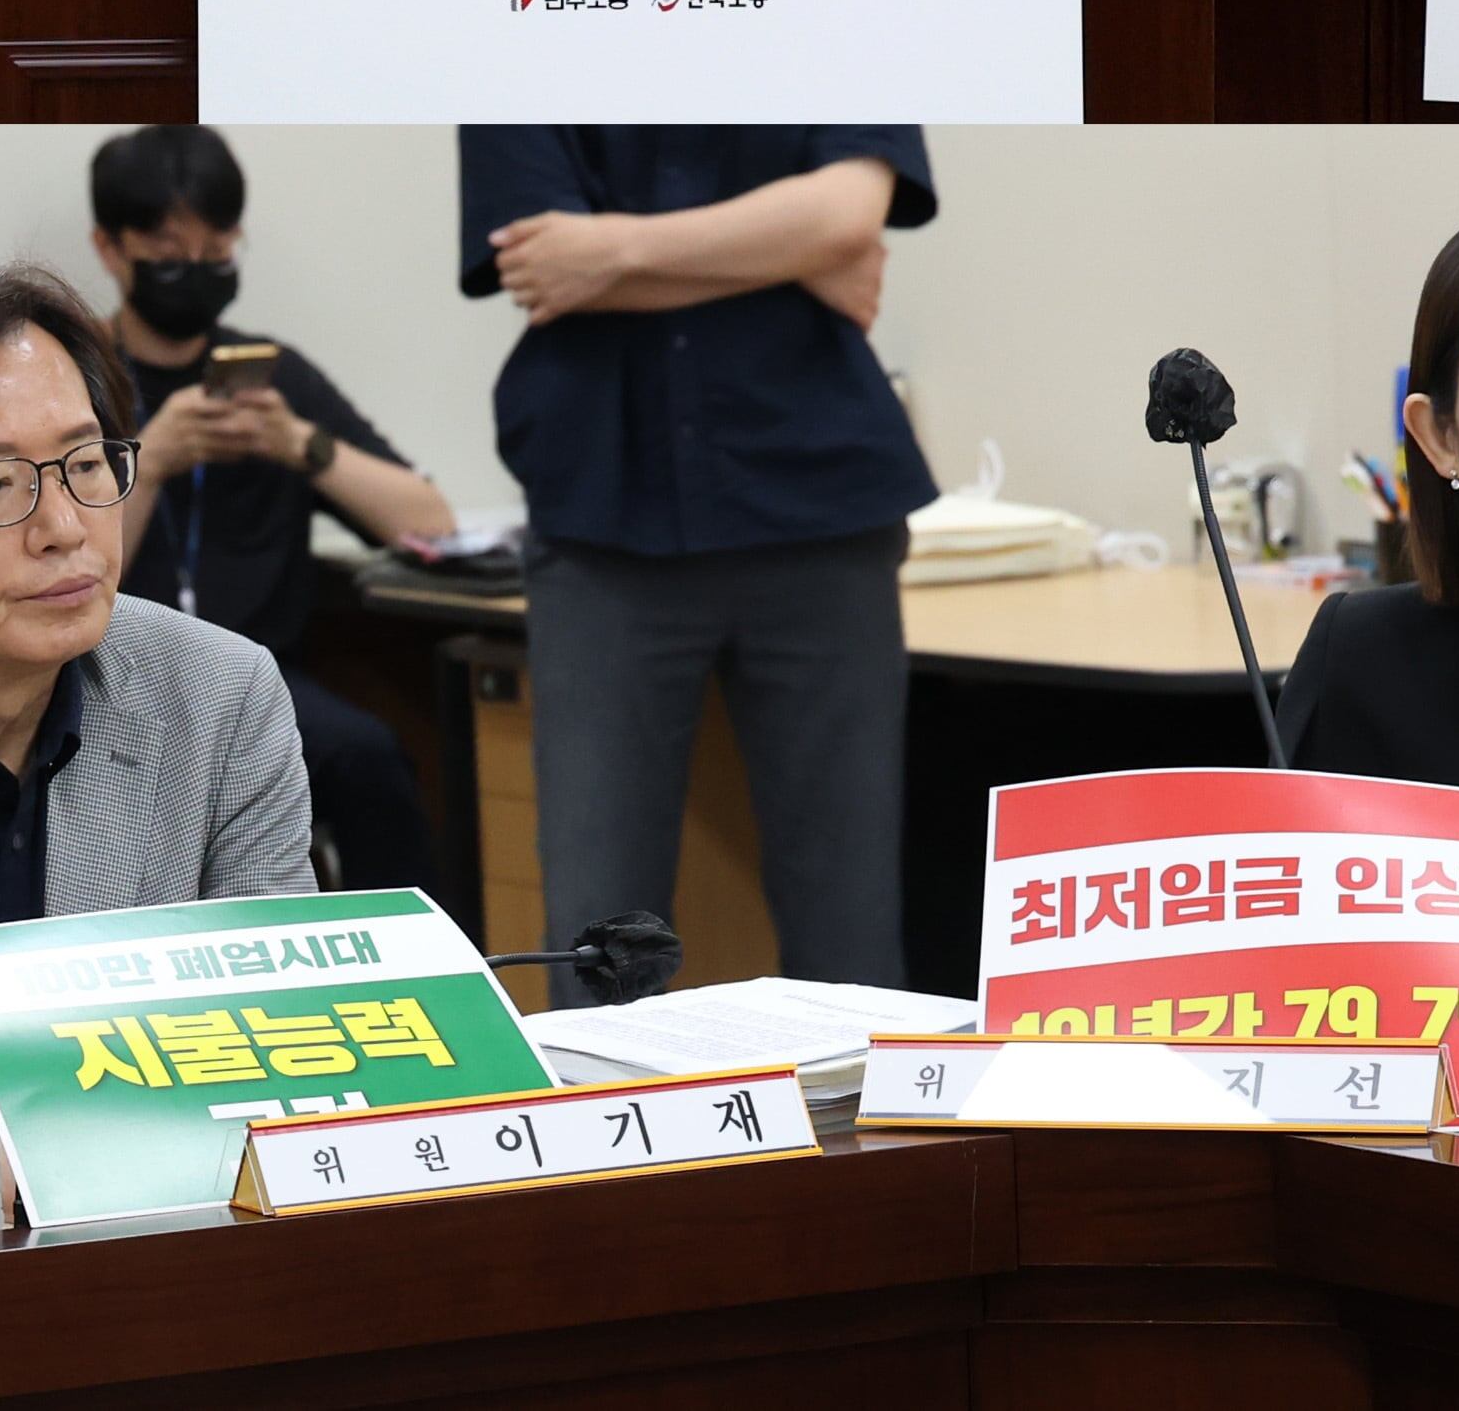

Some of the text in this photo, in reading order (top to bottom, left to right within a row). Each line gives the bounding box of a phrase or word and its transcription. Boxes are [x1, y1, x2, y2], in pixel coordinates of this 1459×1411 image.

[1010, 854, 1304, 947] 최저임금
[165, 930, 382, 982] 폐업시대
[49, 995, 458, 1093] 지불능력
